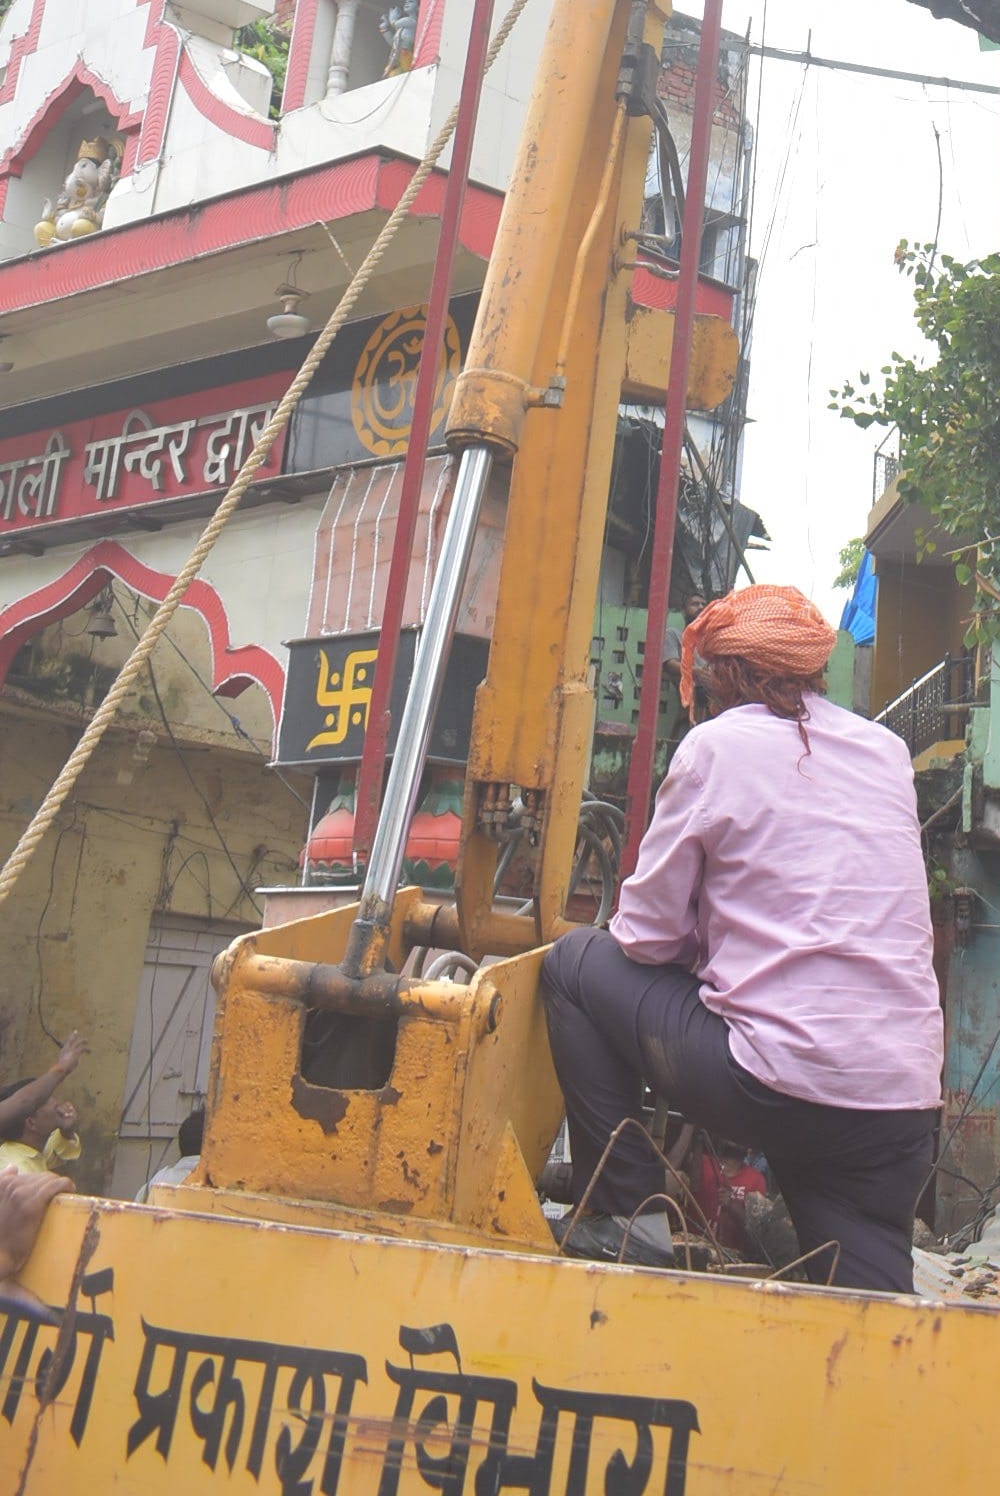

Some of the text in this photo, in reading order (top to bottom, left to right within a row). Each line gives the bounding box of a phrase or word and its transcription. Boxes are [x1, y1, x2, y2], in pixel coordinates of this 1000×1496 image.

[0, 432, 71, 522] ाली
[84, 409, 197, 500] मन्दिर
[126, 1314, 368, 1496] प्रकाश
[378, 1323, 702, 1496] विभाग
